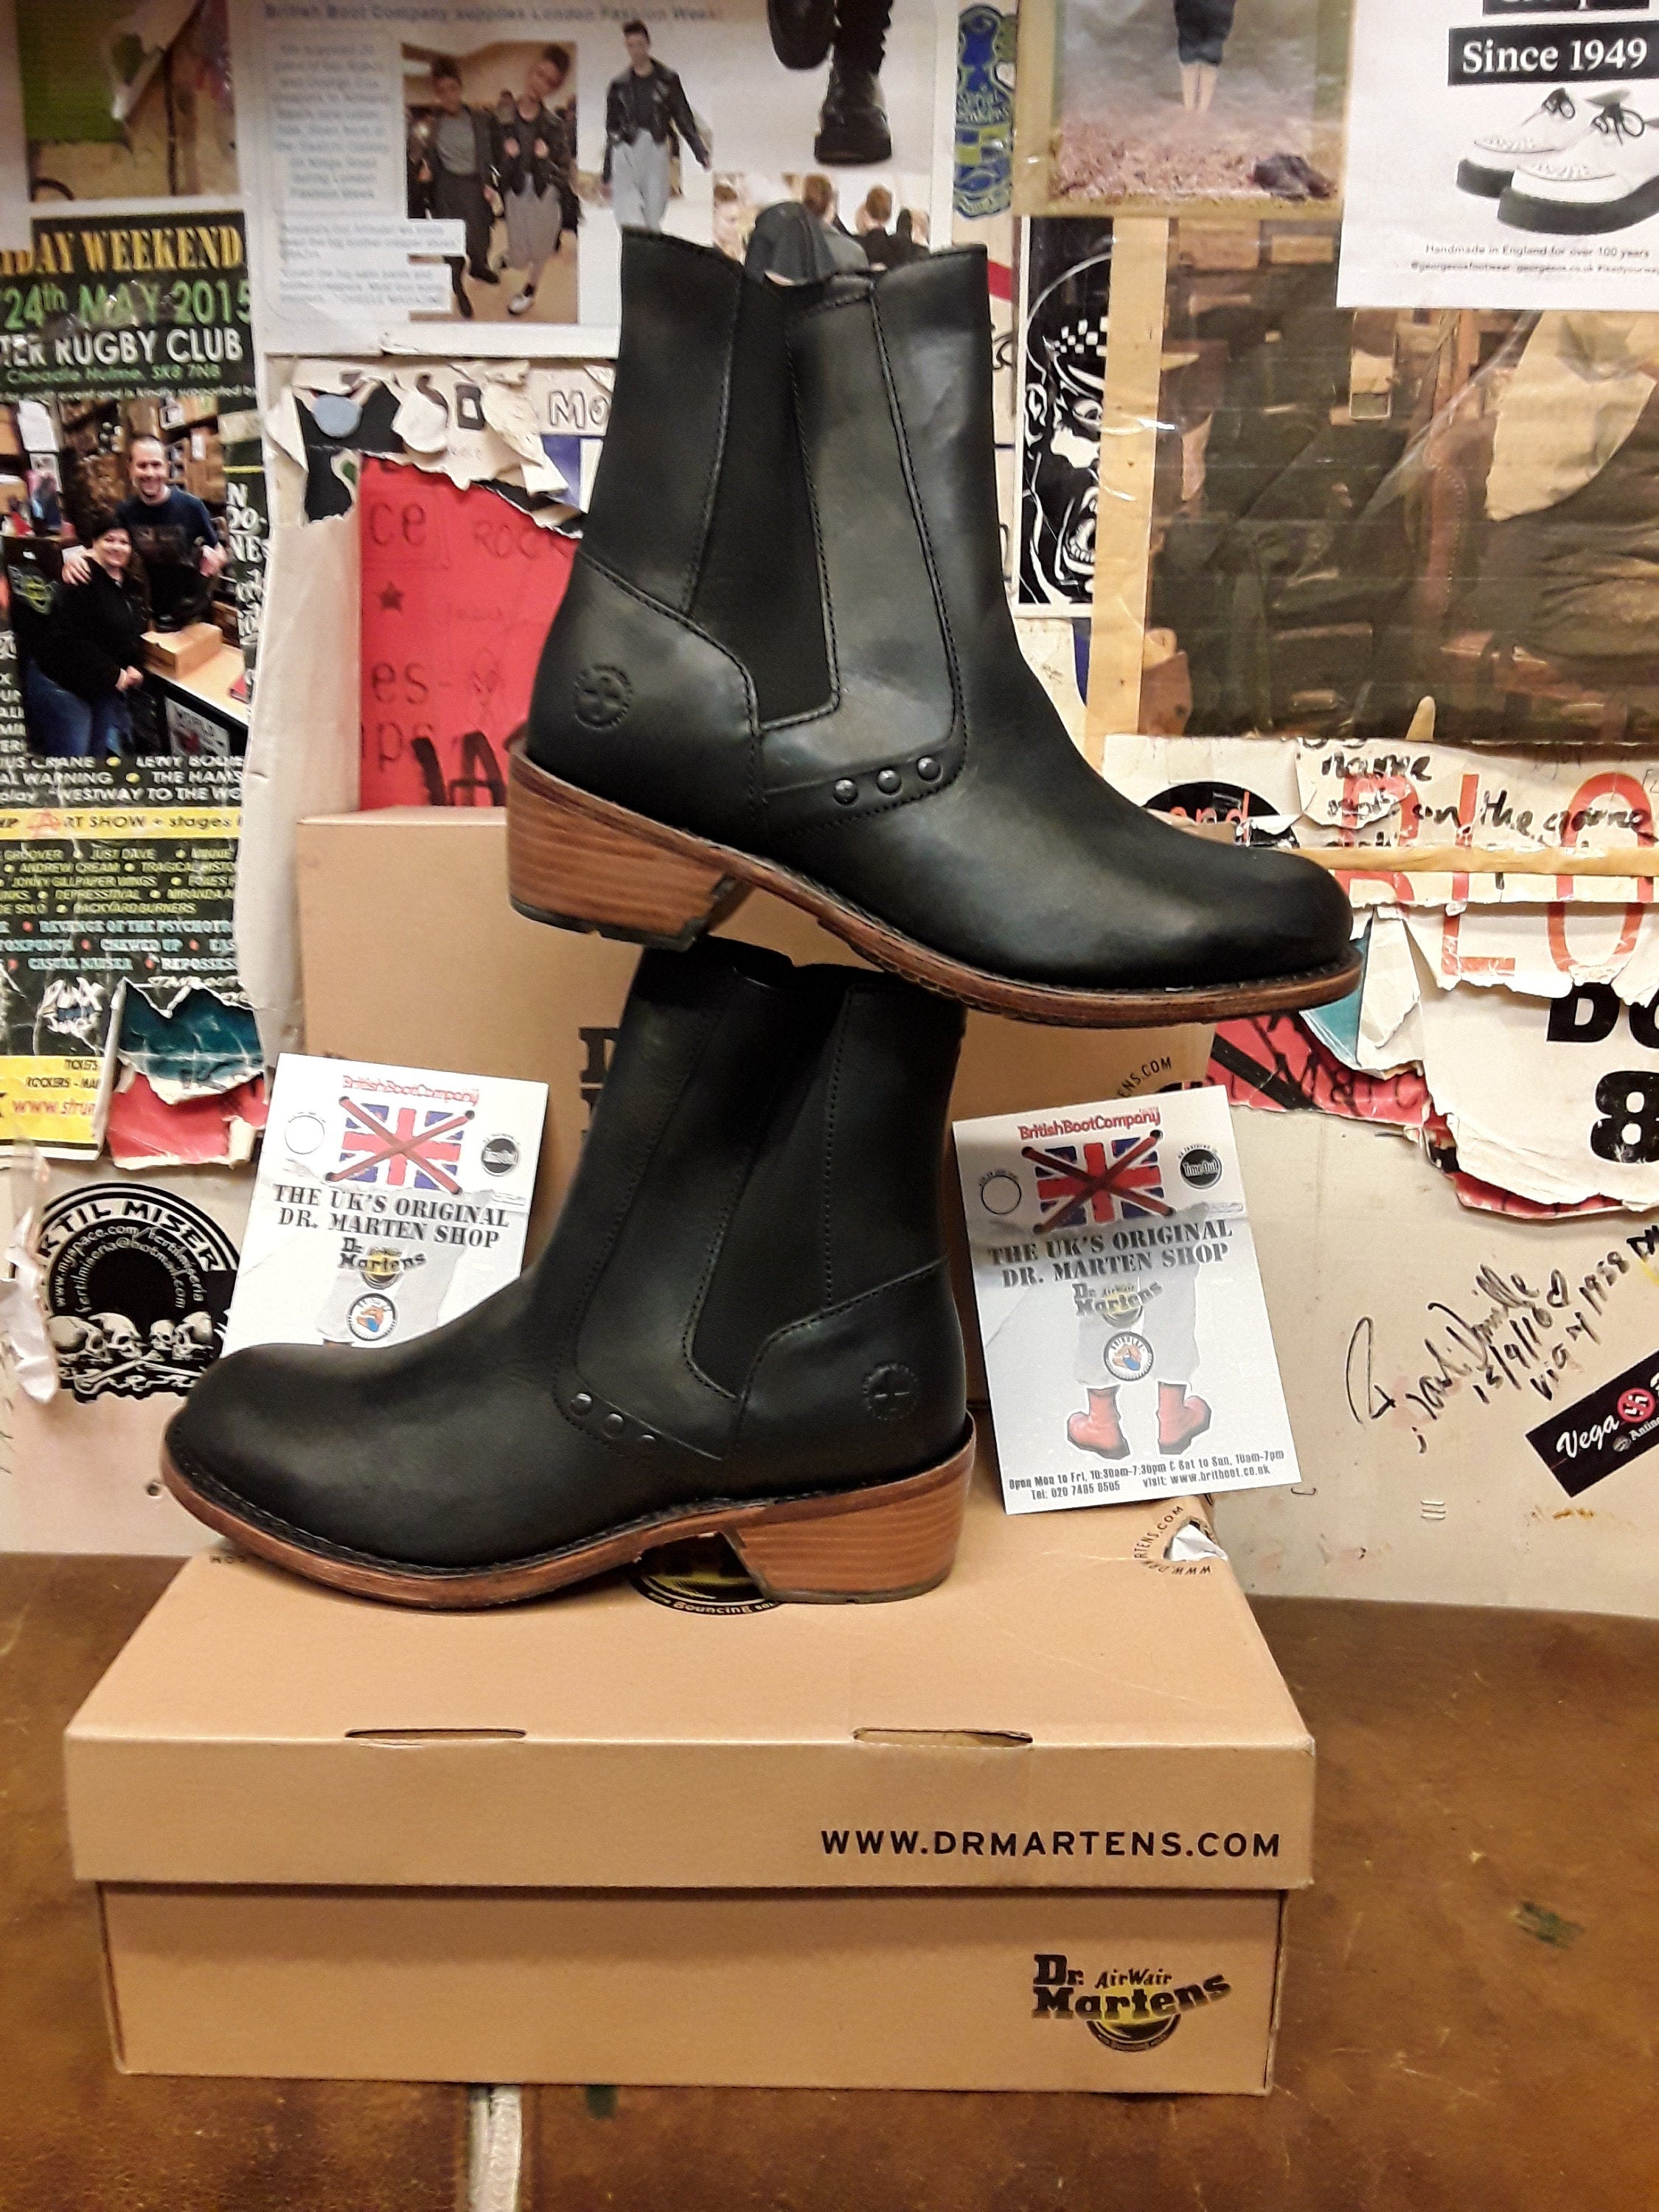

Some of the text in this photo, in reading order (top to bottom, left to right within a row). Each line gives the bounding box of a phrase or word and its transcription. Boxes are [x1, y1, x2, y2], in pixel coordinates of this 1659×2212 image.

[1462, 36, 1648, 74] Since 1949
[80, 226, 243, 273] WEEKEND
[1426, 244, 1485, 255] Handmade
[1489, 245, 1499, 255] in
[1502, 245, 1548, 257] England
[1599, 246, 1618, 257] 100
[3, 282, 68, 331] 24th
[78, 279, 161, 331] MAY
[171, 277, 251, 326] 2015
[55, 329, 158, 367] RUGBY
[165, 327, 244, 364] CLUB
[23, 771, 114, 786] WARNING
[151, 771, 185, 785] THE
[147, 787, 174, 801] TO
[175, 786, 209, 801] THE
[89, 815, 146, 829] SHOW
[169, 815, 232, 830] stages
[1018, 1105, 1161, 1141] BritishBootCompany
[273, 1183, 510, 1228] THE UK'S ORIGINAL
[276, 1206, 501, 1249] DR. MARTEN SHOP
[987, 1218, 1234, 1267] THE UK'S ORIGINAL
[338, 1253, 428, 1272] Martens
[1001, 1242, 1230, 1288] DR. MARTEN SHOP
[1074, 1281, 1164, 1318] Martens
[1556, 1414, 1620, 1458] Vega
[1009, 1478, 1032, 1491] Open
[1034, 1475, 1055, 1487] Mon
[1058, 1473, 1068, 1485] to
[1178, 1458, 1196, 1472] Sat
[1198, 1457, 1209, 1469] to
[1235, 1449, 1285, 1464] 10am-7pm
[1031, 1489, 1048, 1500] Tel:
[1051, 1486, 1069, 1499] 020
[672, 1600, 754, 1615] Bouncing
[821, 1829, 1281, 1858] WWW.DRMARTENS.COM
[1033, 1953, 1172, 1989] Dr. AirWair
[1032, 1973, 1232, 2020] Martens
